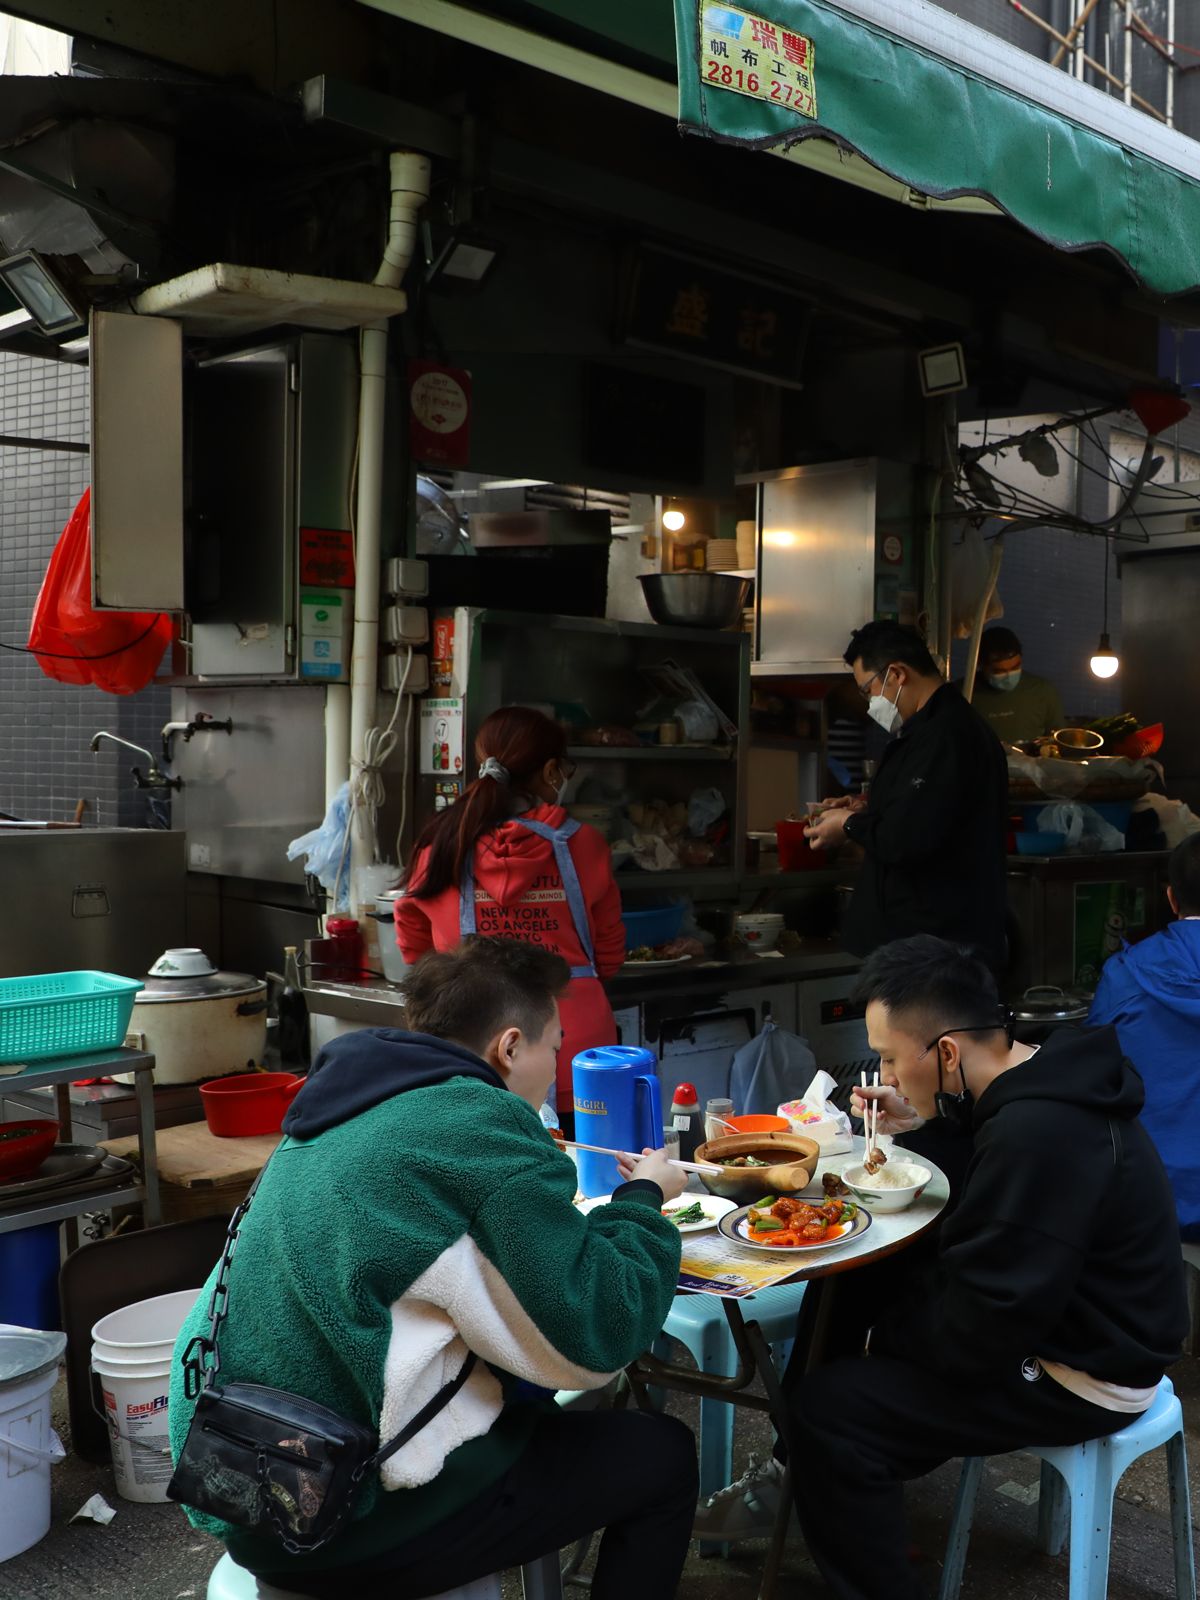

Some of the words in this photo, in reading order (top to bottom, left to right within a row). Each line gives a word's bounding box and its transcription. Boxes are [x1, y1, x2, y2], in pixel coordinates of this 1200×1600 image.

[750, 18, 807, 70] 瑞豐
[710, 39, 810, 91] 帆布工程
[707, 60, 759, 93] 2816
[770, 80, 815, 112] 2727
[539, 891, 563, 900] MINDS
[479, 919, 499, 931] OS
[503, 919, 559, 931] ANGELES
[481, 907, 509, 918] NEW
[513, 907, 549, 919] YORK
